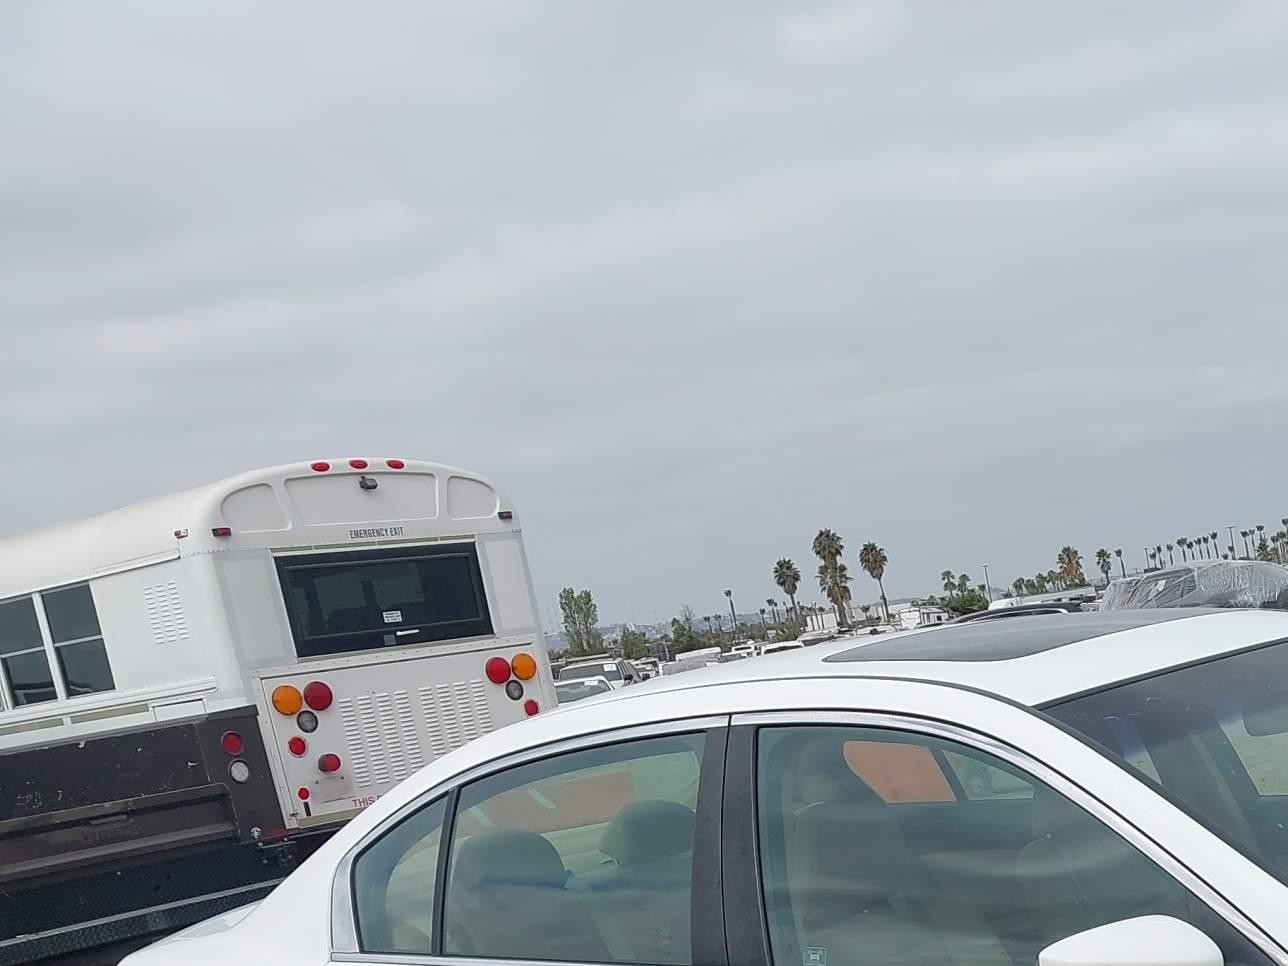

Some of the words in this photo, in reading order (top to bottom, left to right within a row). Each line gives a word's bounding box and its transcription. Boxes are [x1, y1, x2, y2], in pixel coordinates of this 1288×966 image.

[349, 527, 389, 539] EMERGENCY
[389, 526, 404, 537] EXIT
[351, 796, 375, 808] THIS
